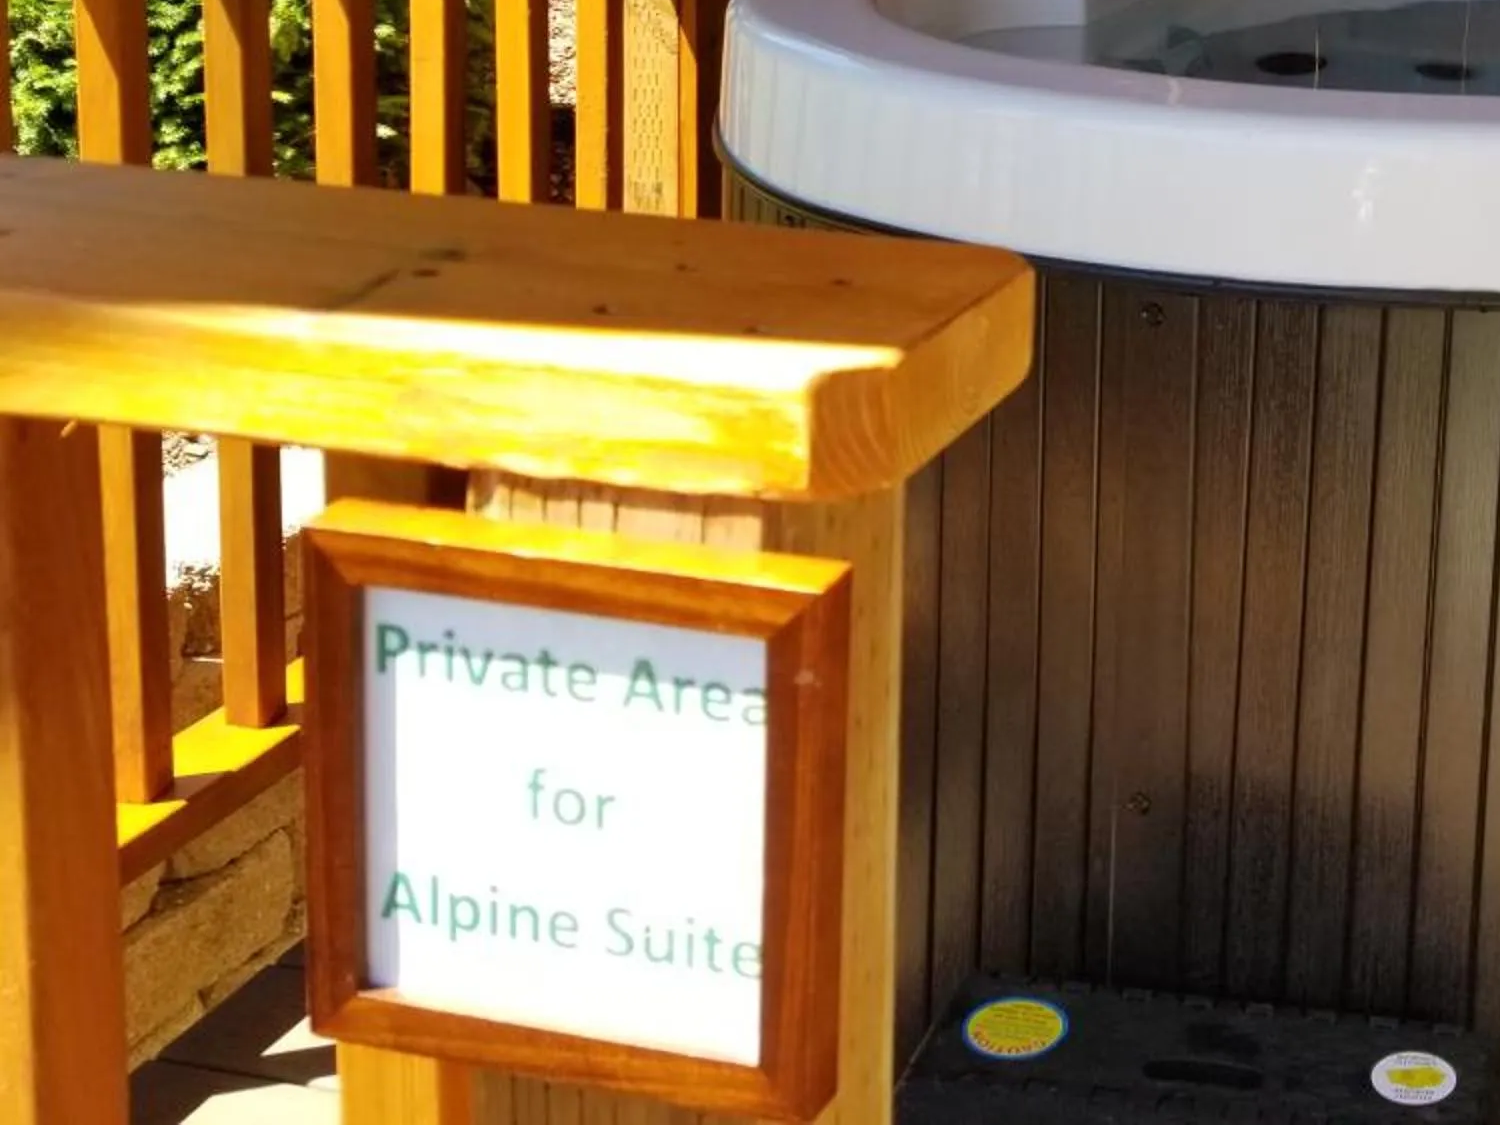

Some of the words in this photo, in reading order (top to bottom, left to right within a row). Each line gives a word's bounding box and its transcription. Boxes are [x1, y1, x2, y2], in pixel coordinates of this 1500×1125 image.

[375, 622, 598, 703] Private
[622, 657, 768, 726] Area
[527, 767, 616, 830] for
[380, 870, 579, 950] Alpine
[605, 907, 763, 979] Suite
